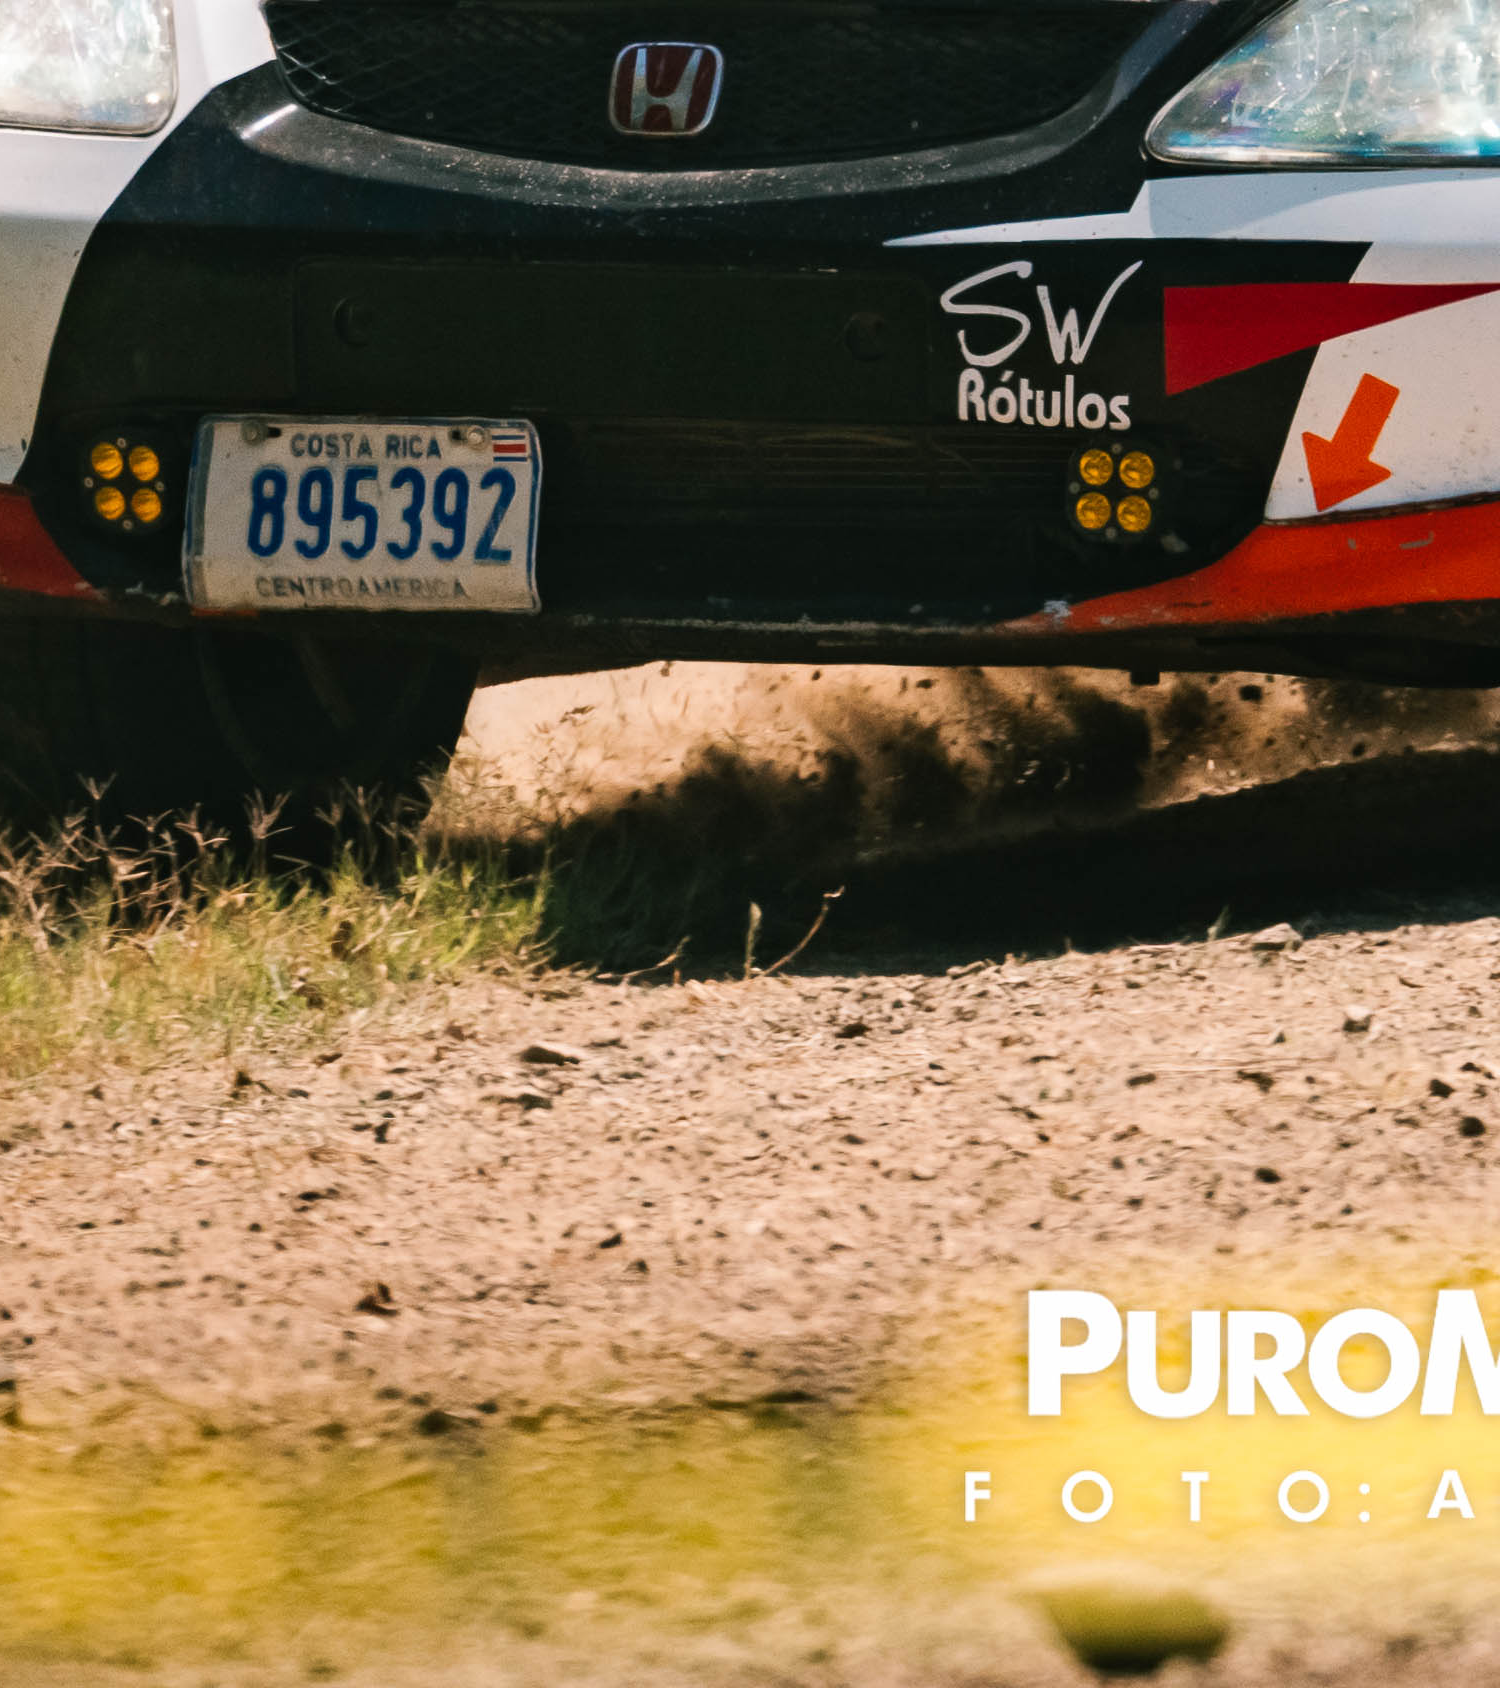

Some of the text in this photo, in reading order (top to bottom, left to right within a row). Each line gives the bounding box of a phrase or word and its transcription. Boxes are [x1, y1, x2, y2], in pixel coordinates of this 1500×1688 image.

[939, 260, 1144, 368] SW
[957, 367, 1132, 431] Rótulos
[290, 432, 443, 460] COSTA RICA
[246, 464, 518, 563] 895392
[254, 575, 471, 600] CENTROAMERICA
